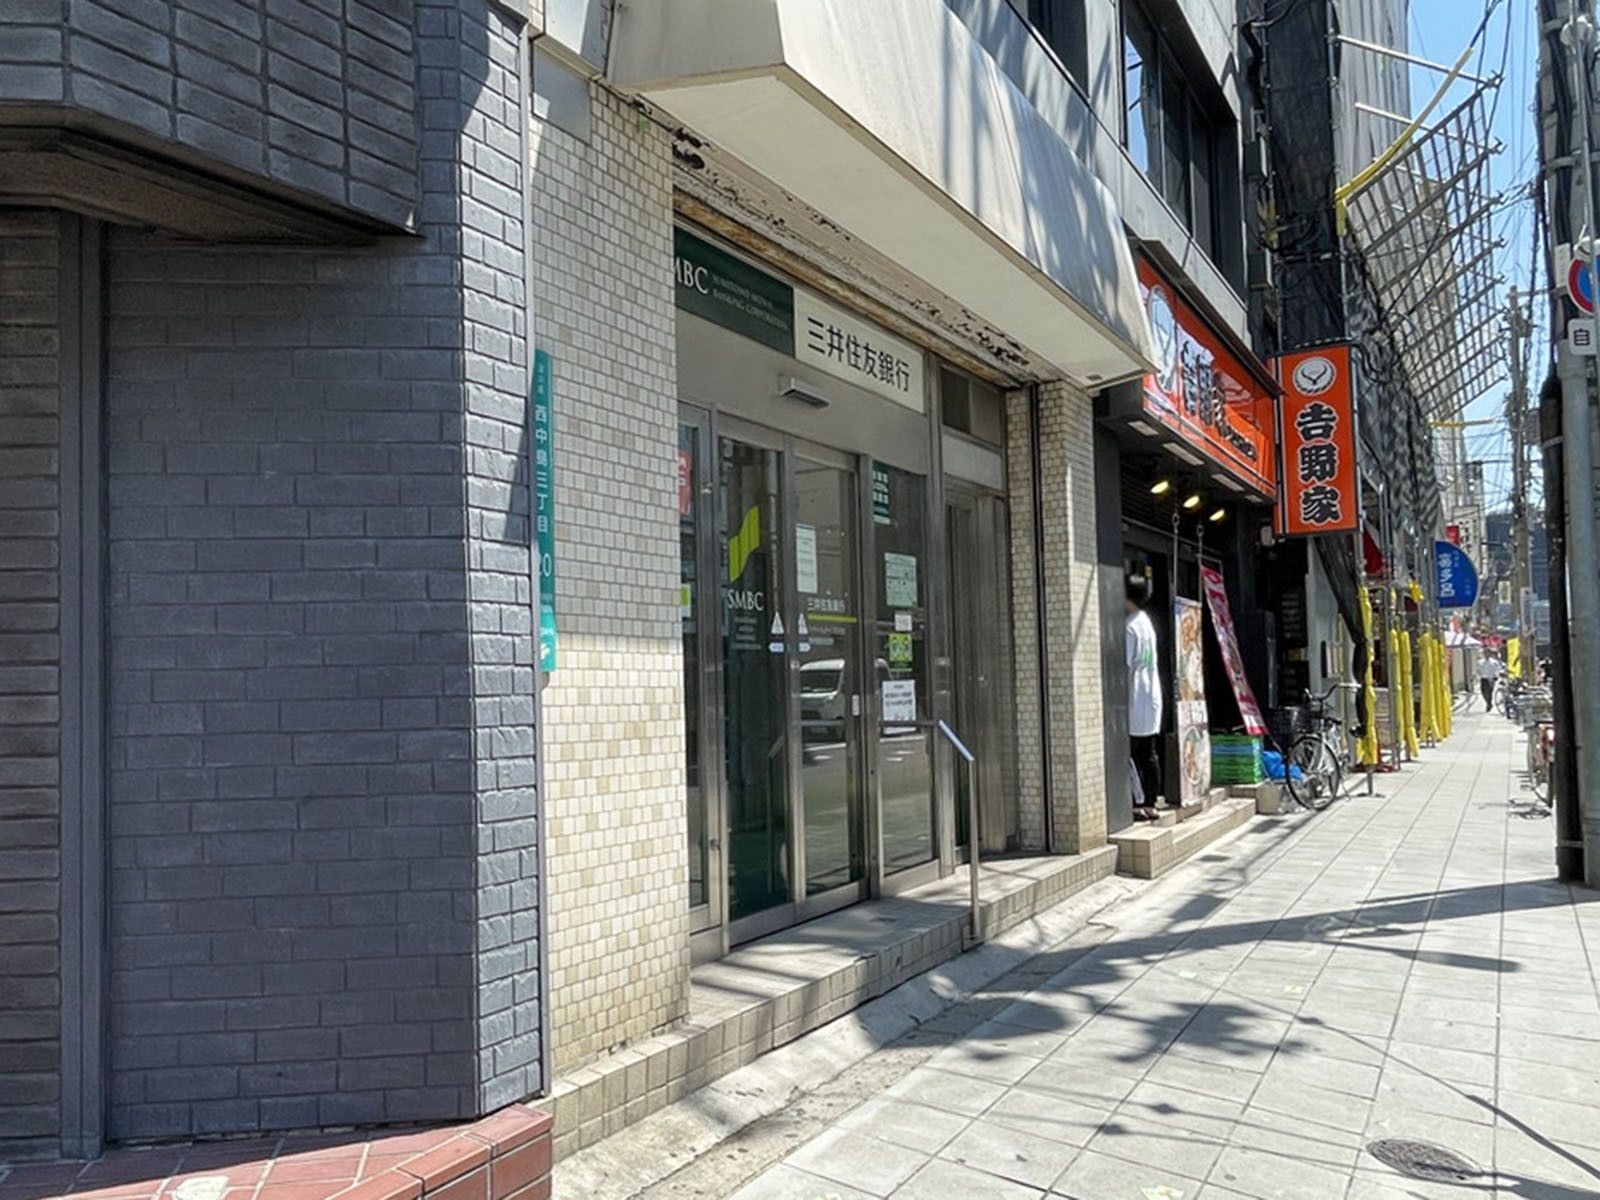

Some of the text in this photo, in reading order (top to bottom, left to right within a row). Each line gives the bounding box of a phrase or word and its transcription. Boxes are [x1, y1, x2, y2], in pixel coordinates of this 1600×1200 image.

[807, 316, 909, 392] 三井住友銀行
[1574, 328, 1590, 346] 自
[1295, 401, 1342, 525] 吉野家
[727, 589, 764, 612] SMBC
